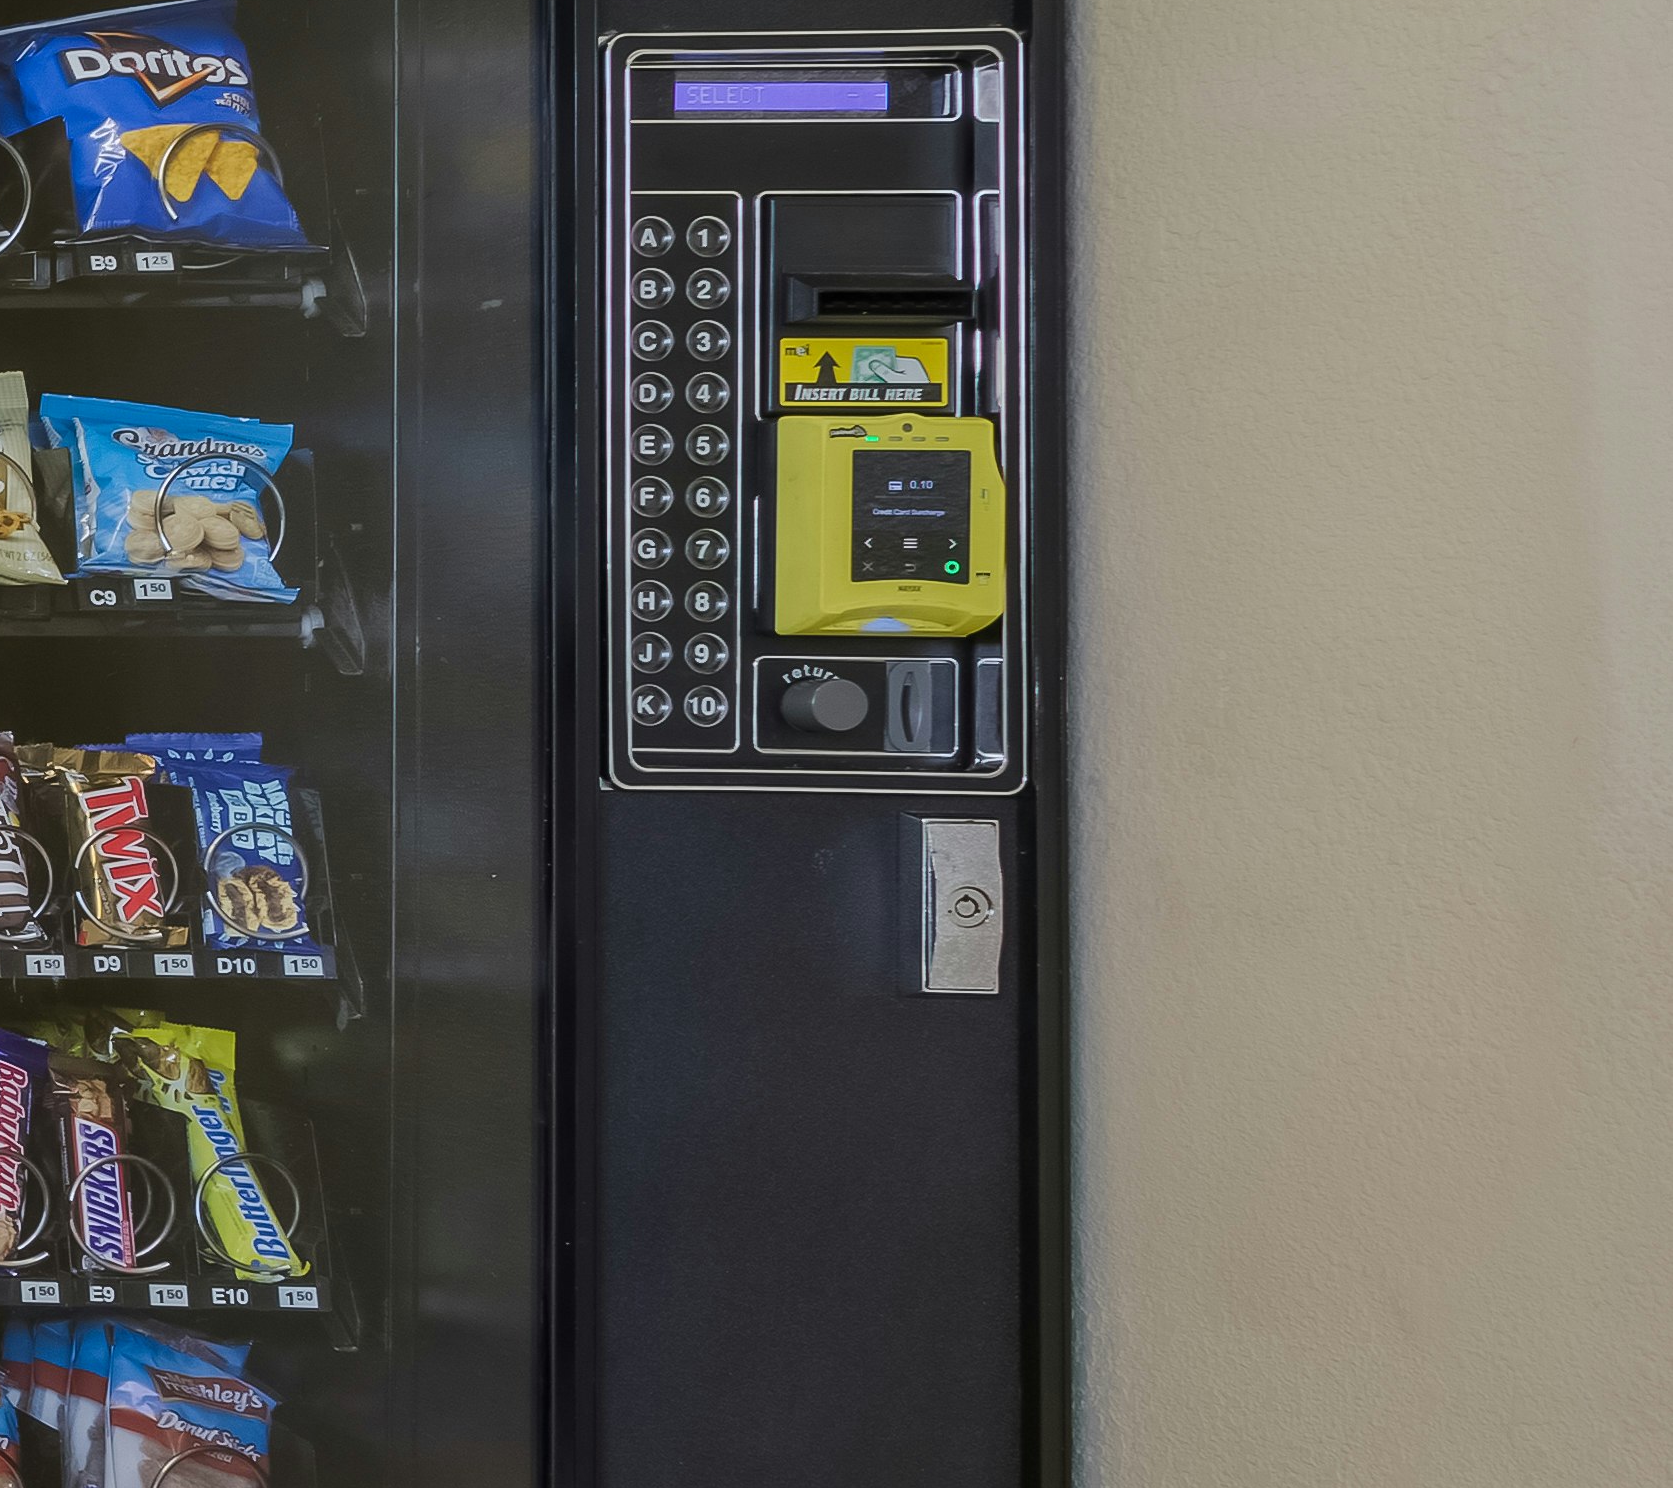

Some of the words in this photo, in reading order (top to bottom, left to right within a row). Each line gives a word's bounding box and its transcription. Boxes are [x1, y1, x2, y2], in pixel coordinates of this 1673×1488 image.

[64, 47, 249, 86] Doritos
[688, 86, 764, 104] SELECT
[640, 228, 657, 247] A
[697, 228, 708, 247] 1
[91, 255, 118, 271] B9
[639, 280, 657, 299] B
[697, 280, 711, 299] 2
[639, 332, 657, 351] C
[696, 332, 711, 351] 3
[639, 384, 657, 402] D
[696, 384, 711, 402] 4
[794, 385, 847, 401] INSERT
[849, 386, 881, 401] BILL
[884, 387, 924, 401] HERE
[639, 435, 656, 454] E
[696, 436, 711, 455] 5
[910, 480, 933, 490] 0.10
[640, 487, 656, 506] F
[695, 488, 710, 507] 6
[637, 539, 656, 559] G
[696, 540, 710, 559] 7
[90, 589, 118, 606] C9
[638, 592, 655, 610] H
[695, 592, 710, 612] 8
[638, 643, 653, 662] J
[694, 644, 709, 663] 9
[637, 695, 655, 715] K
[688, 696, 716, 715] 10
[80, 776, 165, 923] TWIX
[94, 956, 122, 973] D9
[217, 958, 256, 975] D10
[87, 1121, 126, 1266] SNICKERS
[89, 1285, 115, 1302] E9
[211, 1288, 249, 1306] E10
[156, 1411, 220, 1442] Donut
